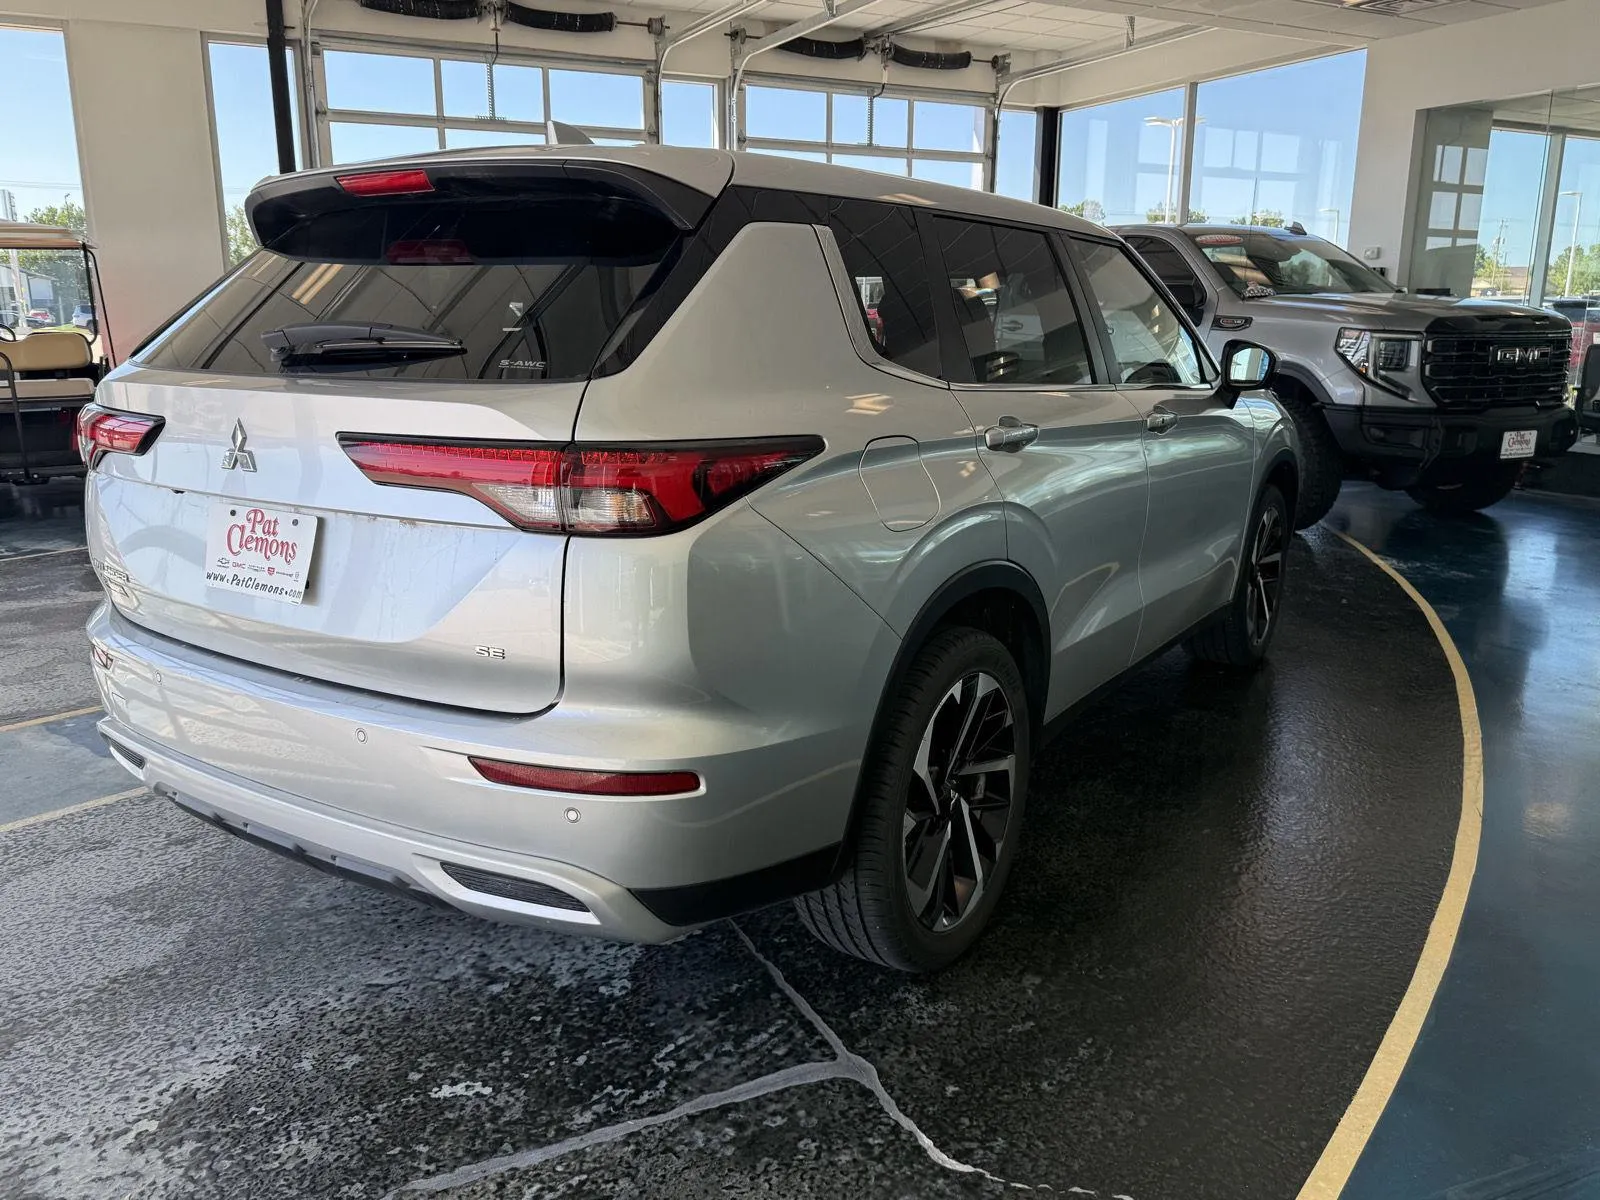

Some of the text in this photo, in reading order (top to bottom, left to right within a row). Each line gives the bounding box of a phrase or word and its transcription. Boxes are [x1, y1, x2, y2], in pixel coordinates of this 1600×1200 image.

[499, 359, 546, 368] S-AWC
[1497, 347, 1550, 363] GMC
[246, 508, 279, 537] Pat
[226, 523, 297, 565] Clemons
[206, 571, 302, 599] www.PatClemons.com
[475, 645, 505, 660] SE
